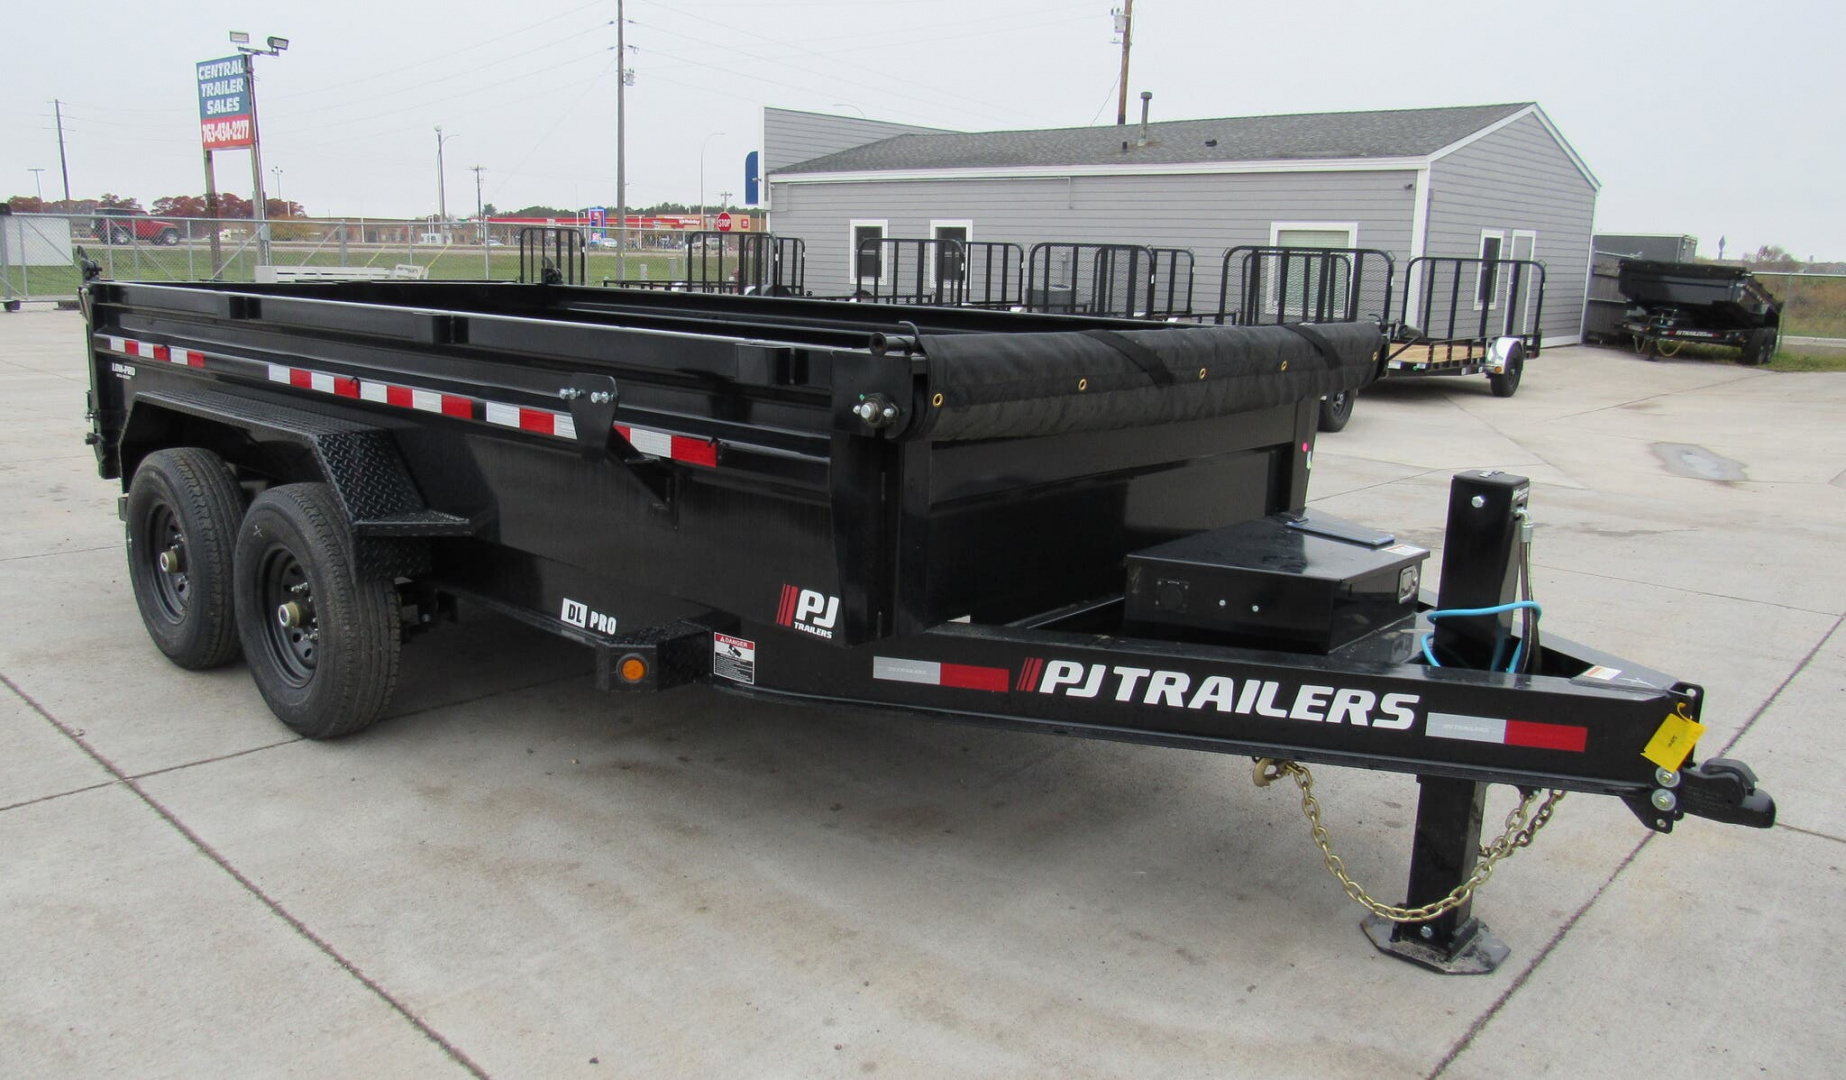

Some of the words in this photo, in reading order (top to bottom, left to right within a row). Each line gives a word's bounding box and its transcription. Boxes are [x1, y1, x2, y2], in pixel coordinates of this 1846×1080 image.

[198, 59, 244, 80] CENTRAL
[201, 78, 244, 97] TRAILER
[206, 97, 240, 115] SALES
[202, 120, 249, 143] 763-434-2277
[718, 219, 731, 228] STOP
[568, 603, 582, 624] DL
[589, 610, 617, 635] PRO
[796, 589, 840, 628] PJ
[794, 621, 832, 639] TRAILERS
[1038, 660, 1107, 698] PJ
[1113, 666, 1420, 730] TRAILERS
